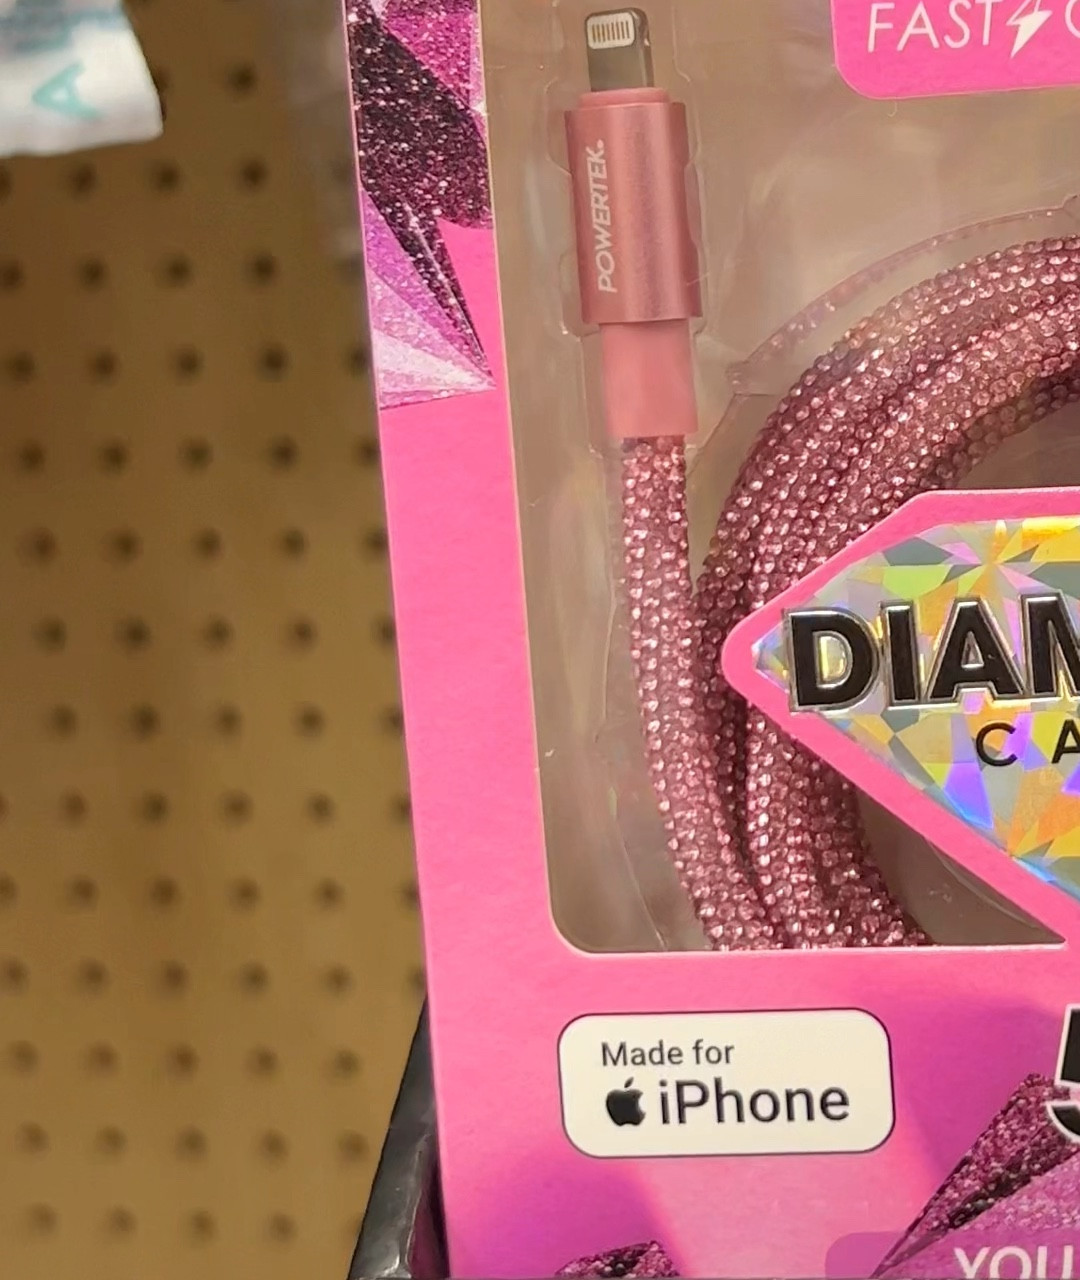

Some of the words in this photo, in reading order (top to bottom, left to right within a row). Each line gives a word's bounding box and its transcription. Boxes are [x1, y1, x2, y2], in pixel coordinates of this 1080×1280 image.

[601, 1039, 684, 1067] Made
[692, 1038, 735, 1065] for
[658, 1076, 850, 1125] iPhone
[954, 1244, 1073, 1280] YOU
